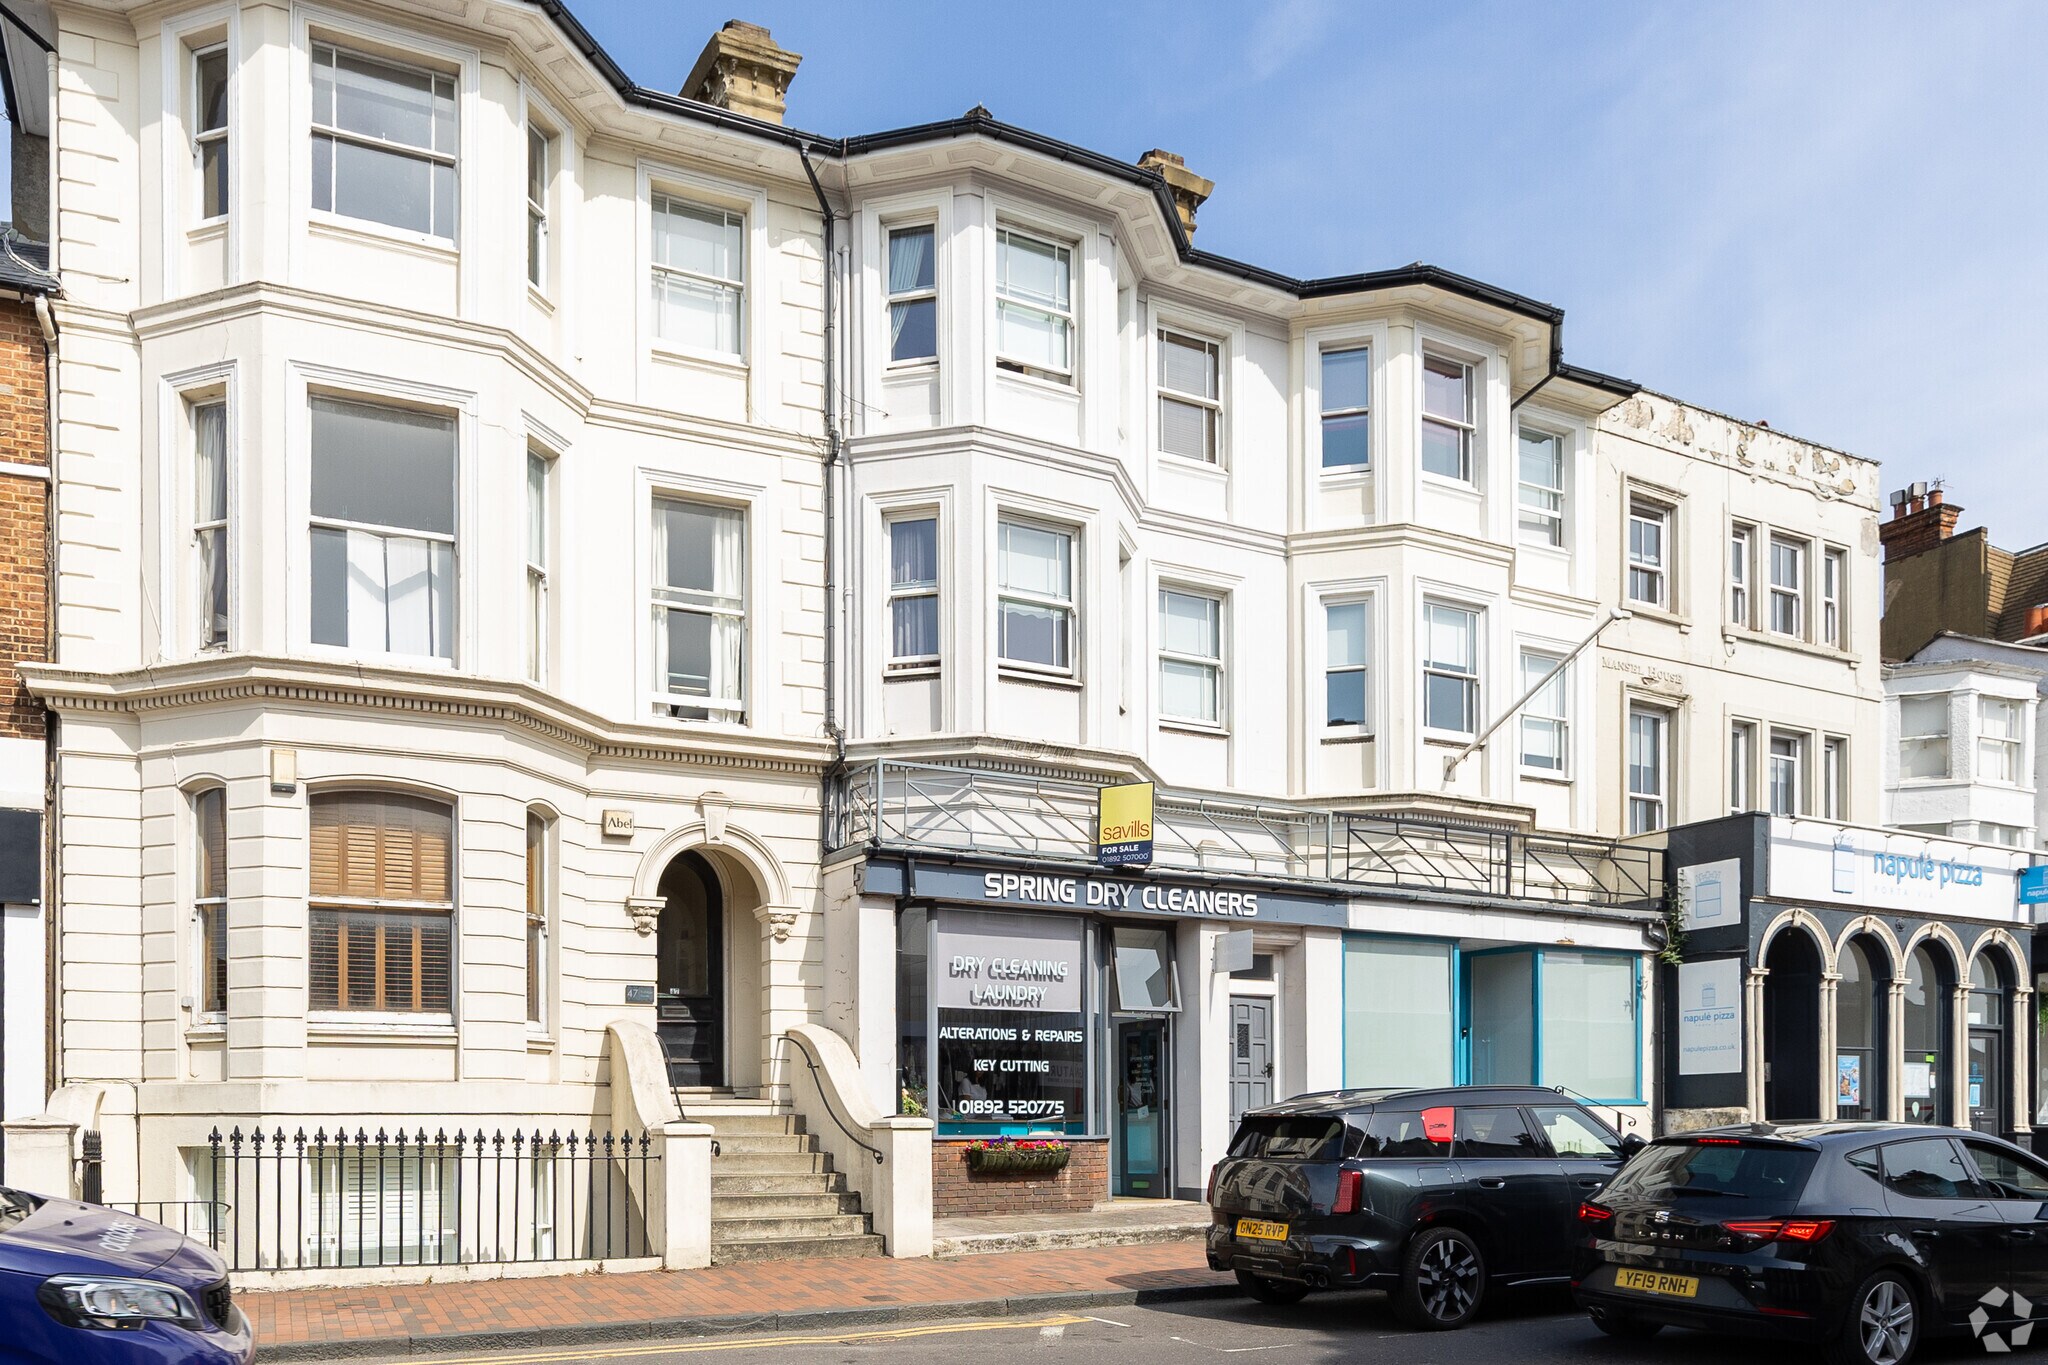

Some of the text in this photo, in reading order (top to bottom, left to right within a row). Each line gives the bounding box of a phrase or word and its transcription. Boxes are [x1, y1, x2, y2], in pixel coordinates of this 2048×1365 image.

[607, 817, 632, 829] Abel
[1102, 820, 1150, 841] savills
[1101, 844, 1139, 854] FOR SALE
[1101, 853, 1149, 863] 01892 507000
[1939, 856, 1983, 890] pizza
[984, 873, 1258, 917] SPRING DRY CLEANERS
[953, 955, 1069, 976] DRY CLEANING
[627, 988, 639, 998] 47
[974, 984, 1048, 1002] LAUNDRY
[1713, 1011, 1735, 1022] pizza
[939, 1027, 1083, 1043] ALTERATIONS & REPAIRS
[974, 1059, 1050, 1072] KEY CUTTING
[959, 1100, 1064, 1114] 01892 520775
[1240, 1222, 1284, 1237] GN25 RVP
[1638, 1230, 1684, 1241] LEON
[1626, 1271, 1689, 1294] YF19 RNH
